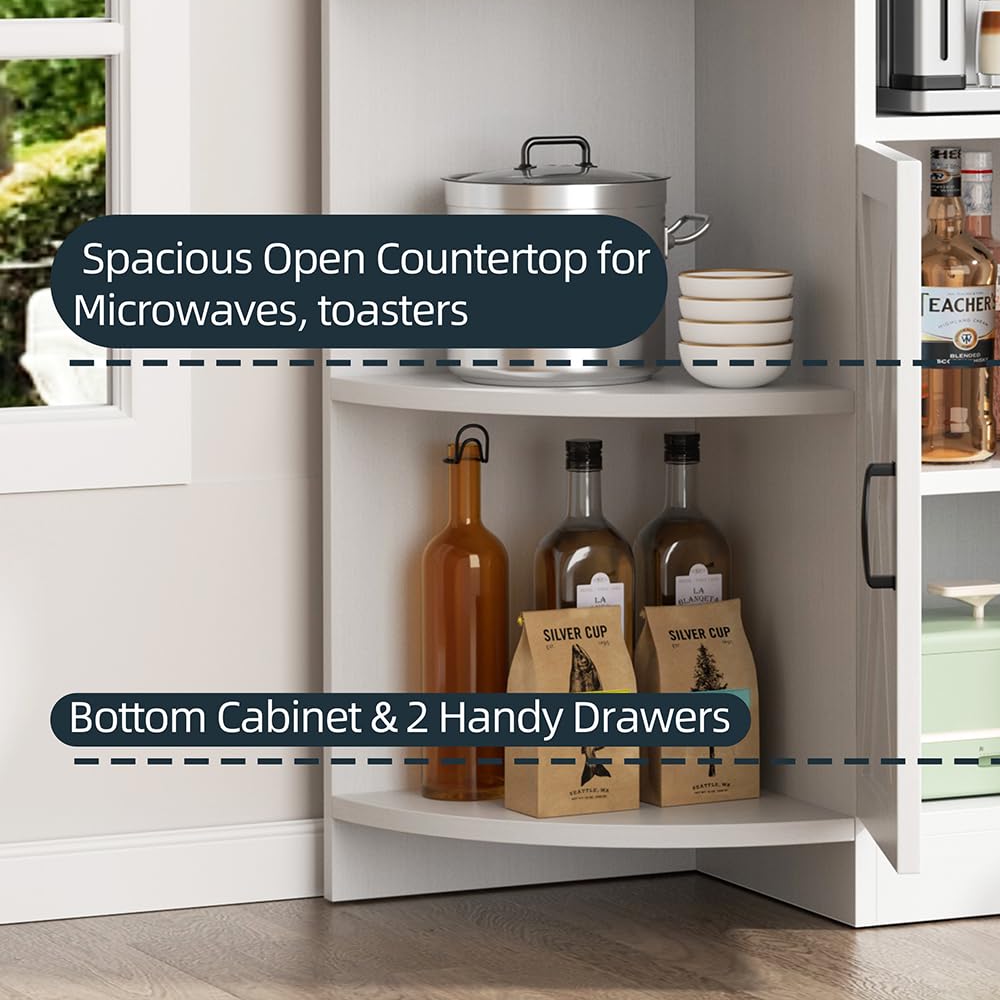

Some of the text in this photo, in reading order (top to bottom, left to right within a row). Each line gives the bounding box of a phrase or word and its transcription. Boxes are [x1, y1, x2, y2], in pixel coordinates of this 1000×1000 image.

[543, 625, 608, 642] SILVER CUP
[668, 626, 731, 641] SILVER CUP
